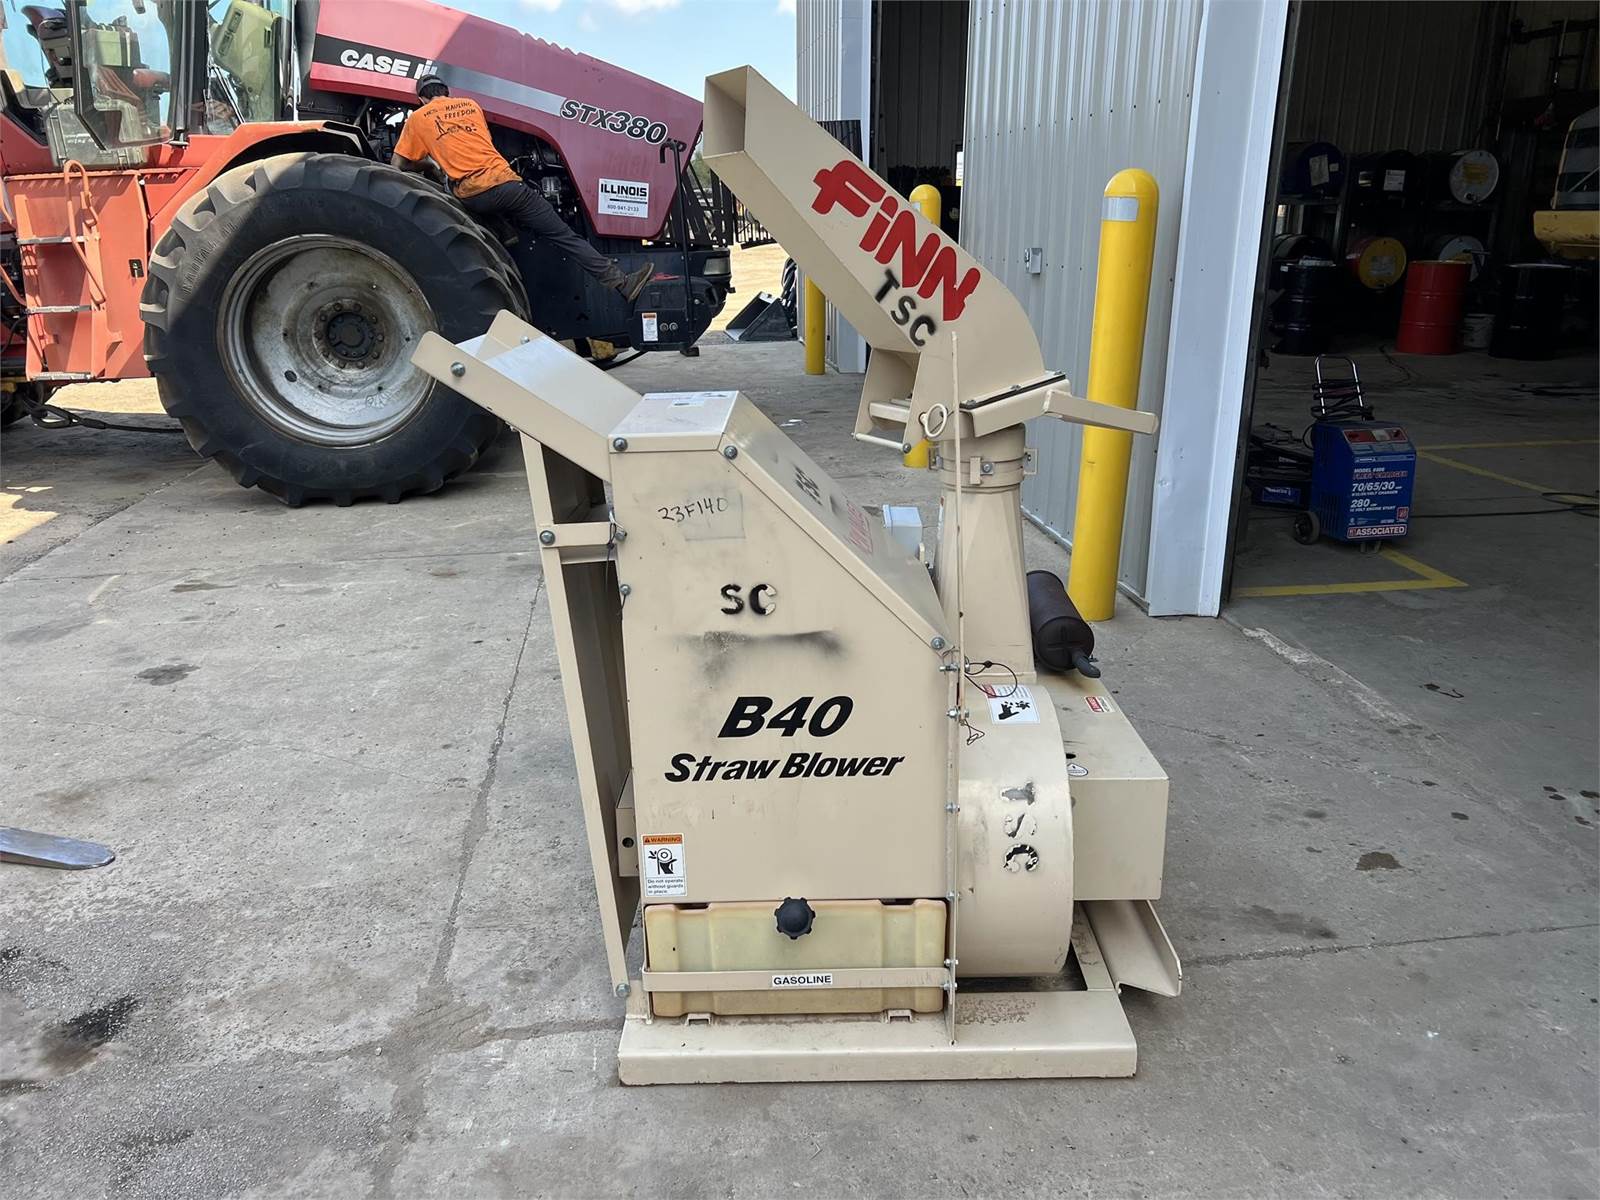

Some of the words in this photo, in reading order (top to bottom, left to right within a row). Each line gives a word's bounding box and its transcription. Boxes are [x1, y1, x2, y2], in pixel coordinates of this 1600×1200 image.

[340, 49, 411, 77] CASE
[444, 108, 476, 119] FREEDOM
[560, 99, 669, 145] STX380
[600, 183, 648, 197] ILLINOIS
[874, 268, 937, 347] TSC
[1351, 481, 1396, 492] 70/65/30
[656, 496, 729, 523] 23F140
[1350, 498, 1370, 508] 280
[1356, 526, 1405, 536] ASSOCIATED
[717, 695, 855, 739] B40
[664, 752, 781, 783] Straw
[778, 751, 906, 779] Blower
[773, 975, 832, 985] GASOLINE
